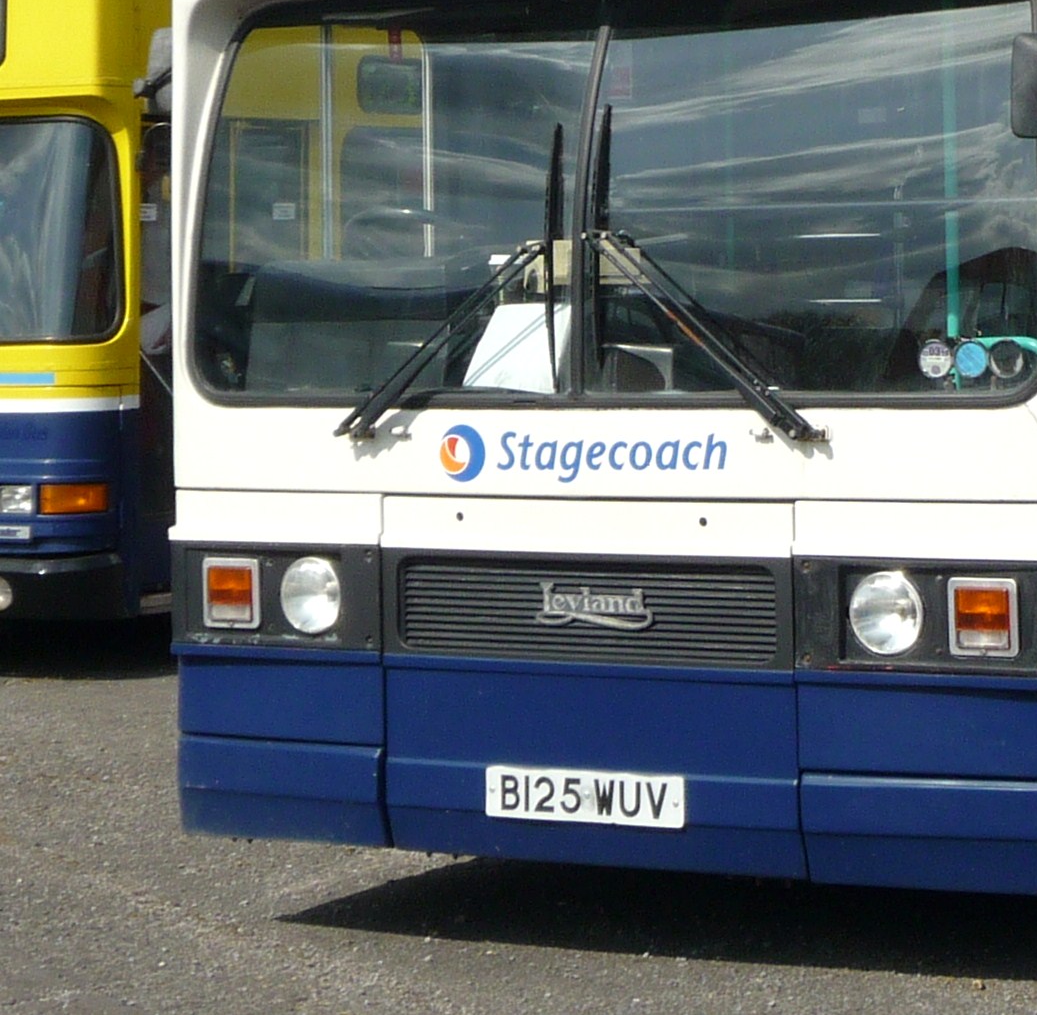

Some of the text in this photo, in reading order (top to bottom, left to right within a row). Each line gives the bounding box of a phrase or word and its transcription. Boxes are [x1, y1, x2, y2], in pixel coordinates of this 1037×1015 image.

[496, 430, 728, 484] Stagecoach
[500, 774, 669, 820] B125 WUV
